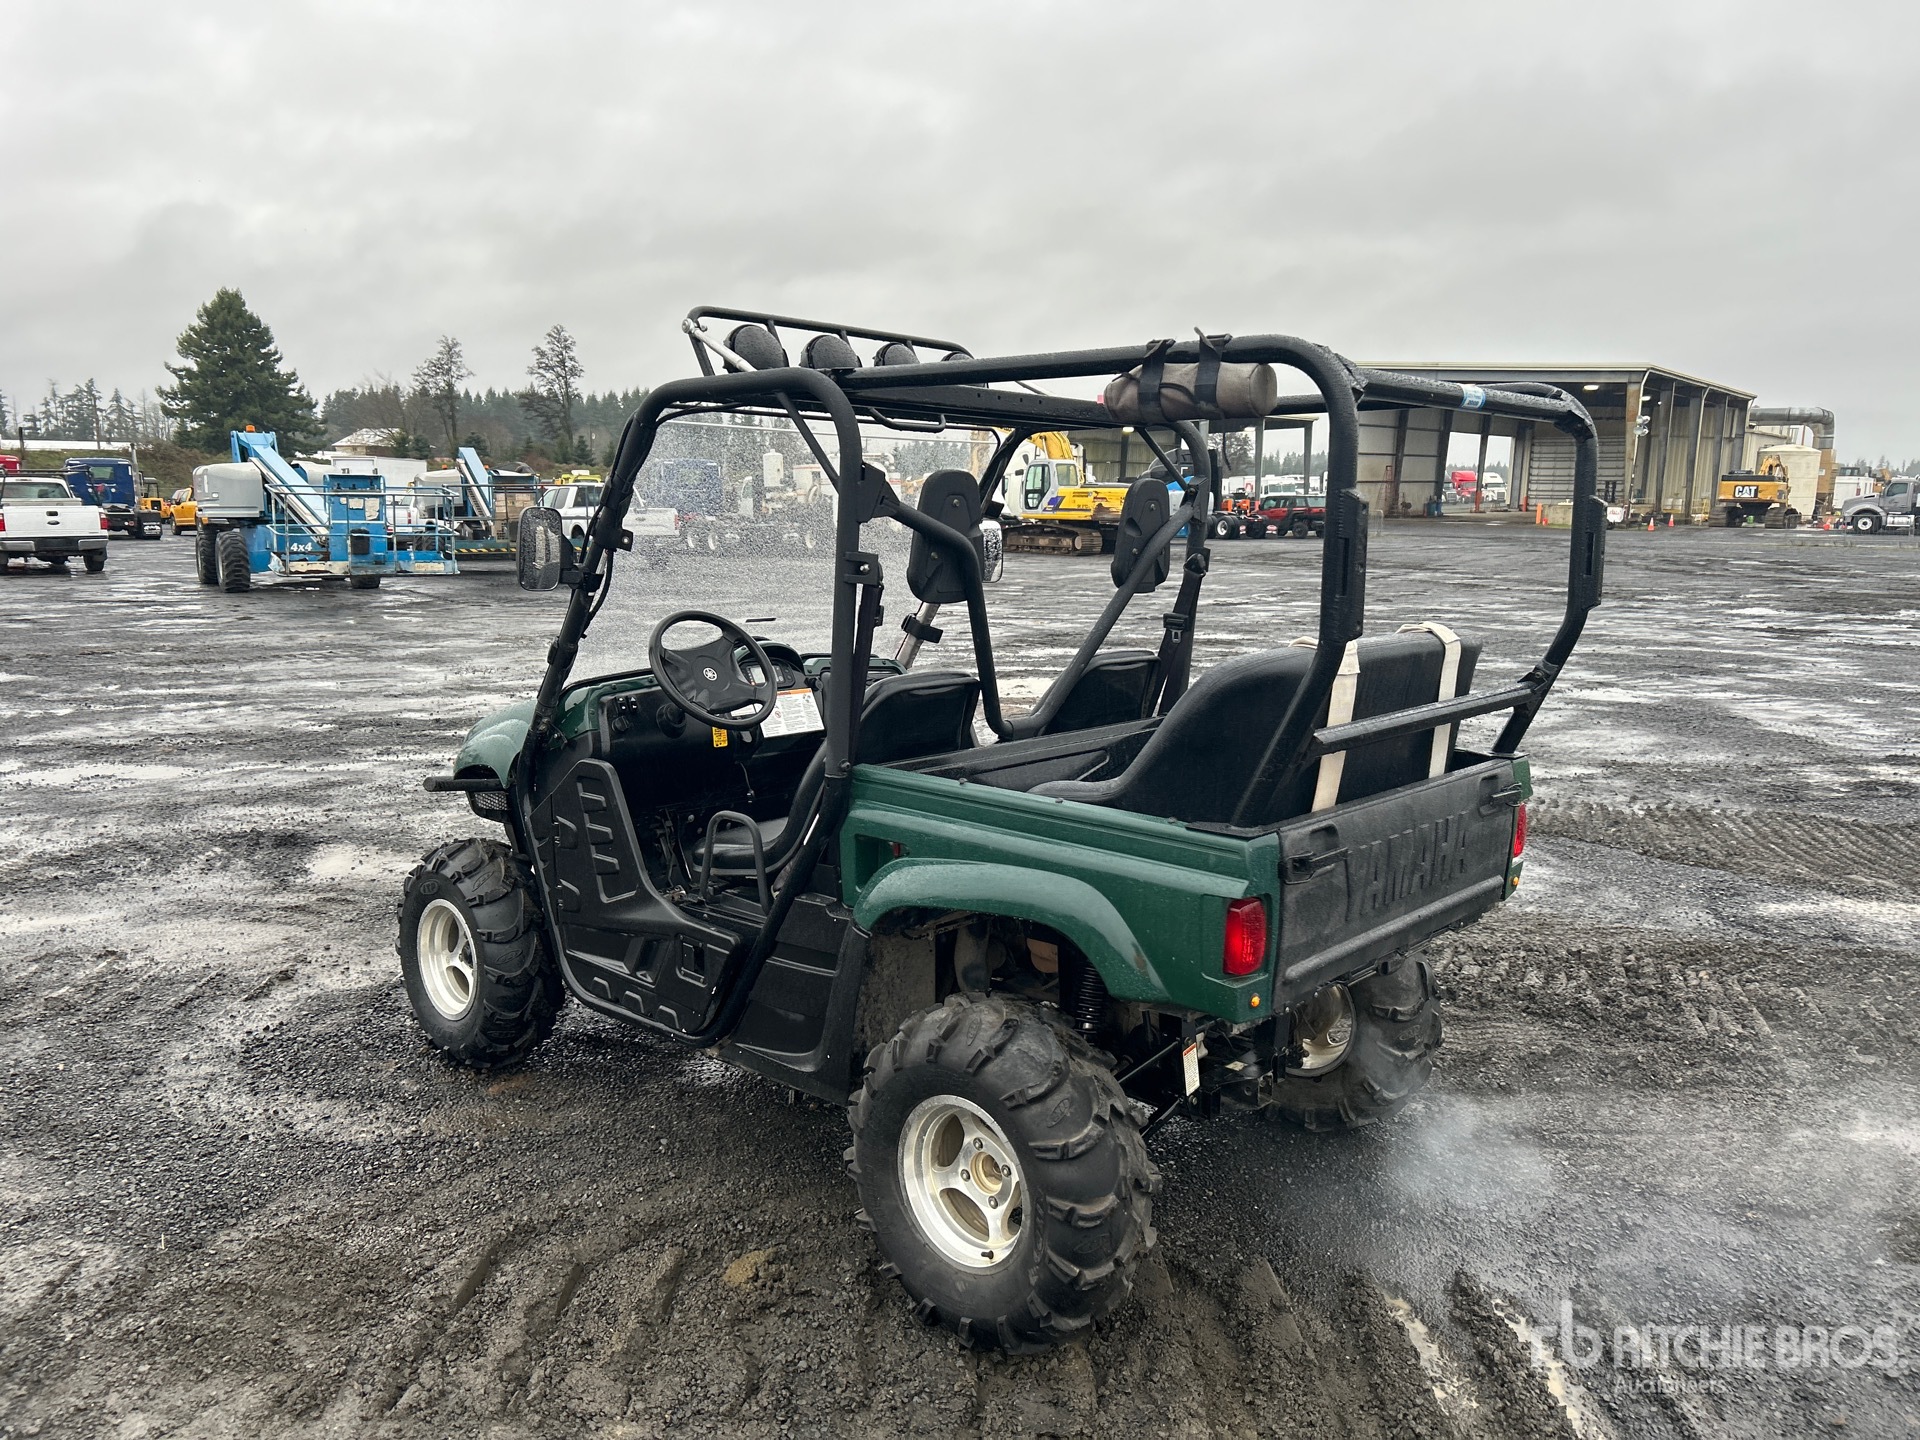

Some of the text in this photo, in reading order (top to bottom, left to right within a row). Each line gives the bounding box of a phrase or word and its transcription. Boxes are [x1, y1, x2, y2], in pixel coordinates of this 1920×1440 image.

[1734, 486, 1757, 498] CAT
[290, 542, 313, 552] 4x4
[1343, 810, 1474, 922] YAMAHA
